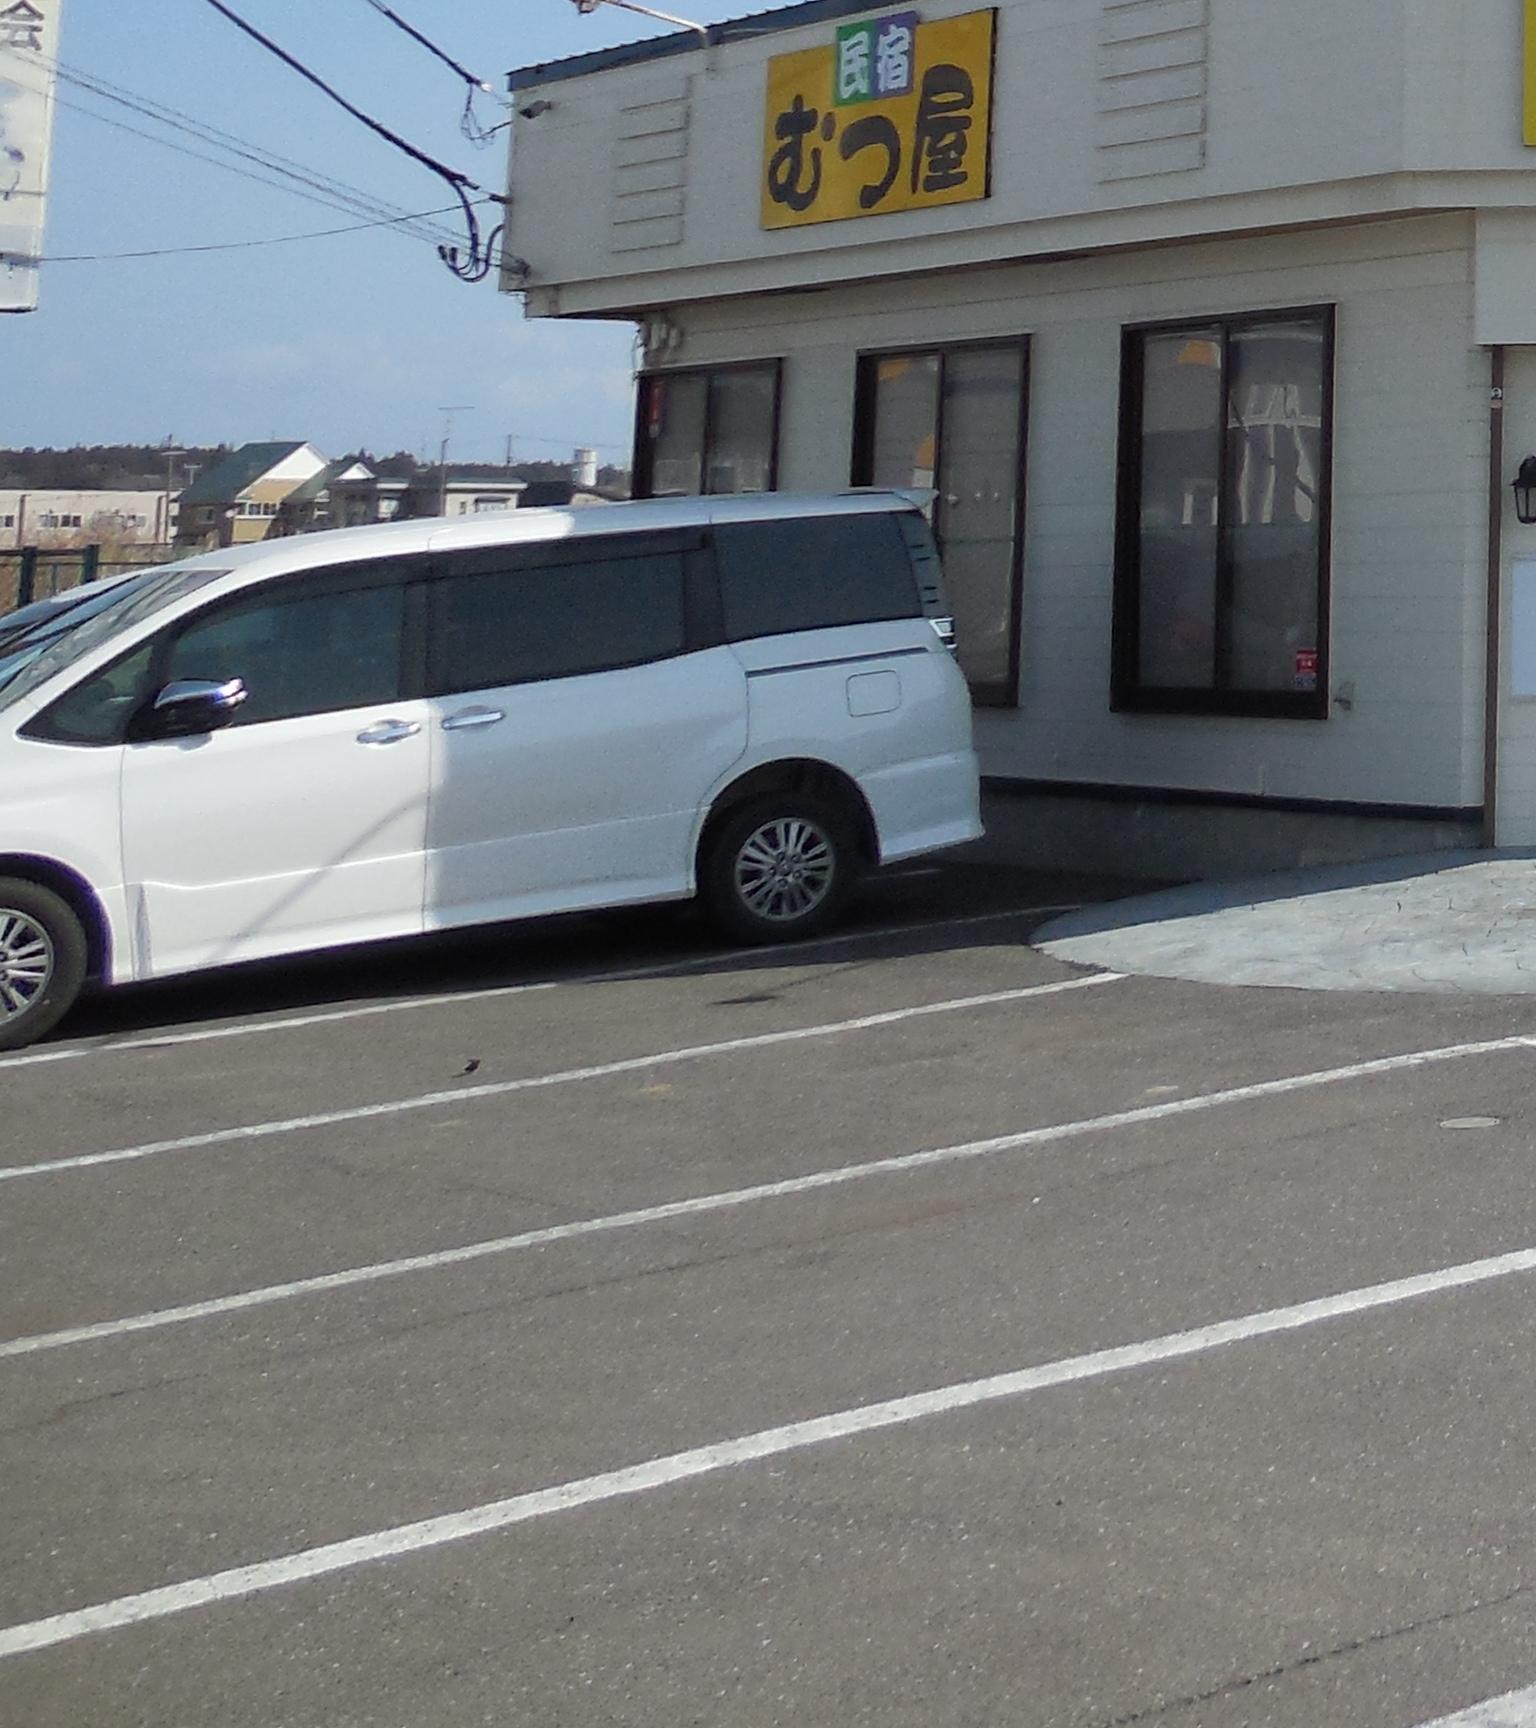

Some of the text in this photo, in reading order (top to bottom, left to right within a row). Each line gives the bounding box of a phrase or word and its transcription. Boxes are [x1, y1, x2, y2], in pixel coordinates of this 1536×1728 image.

[838, 24, 911, 100] 民宿
[767, 62, 975, 212] むつ屋
